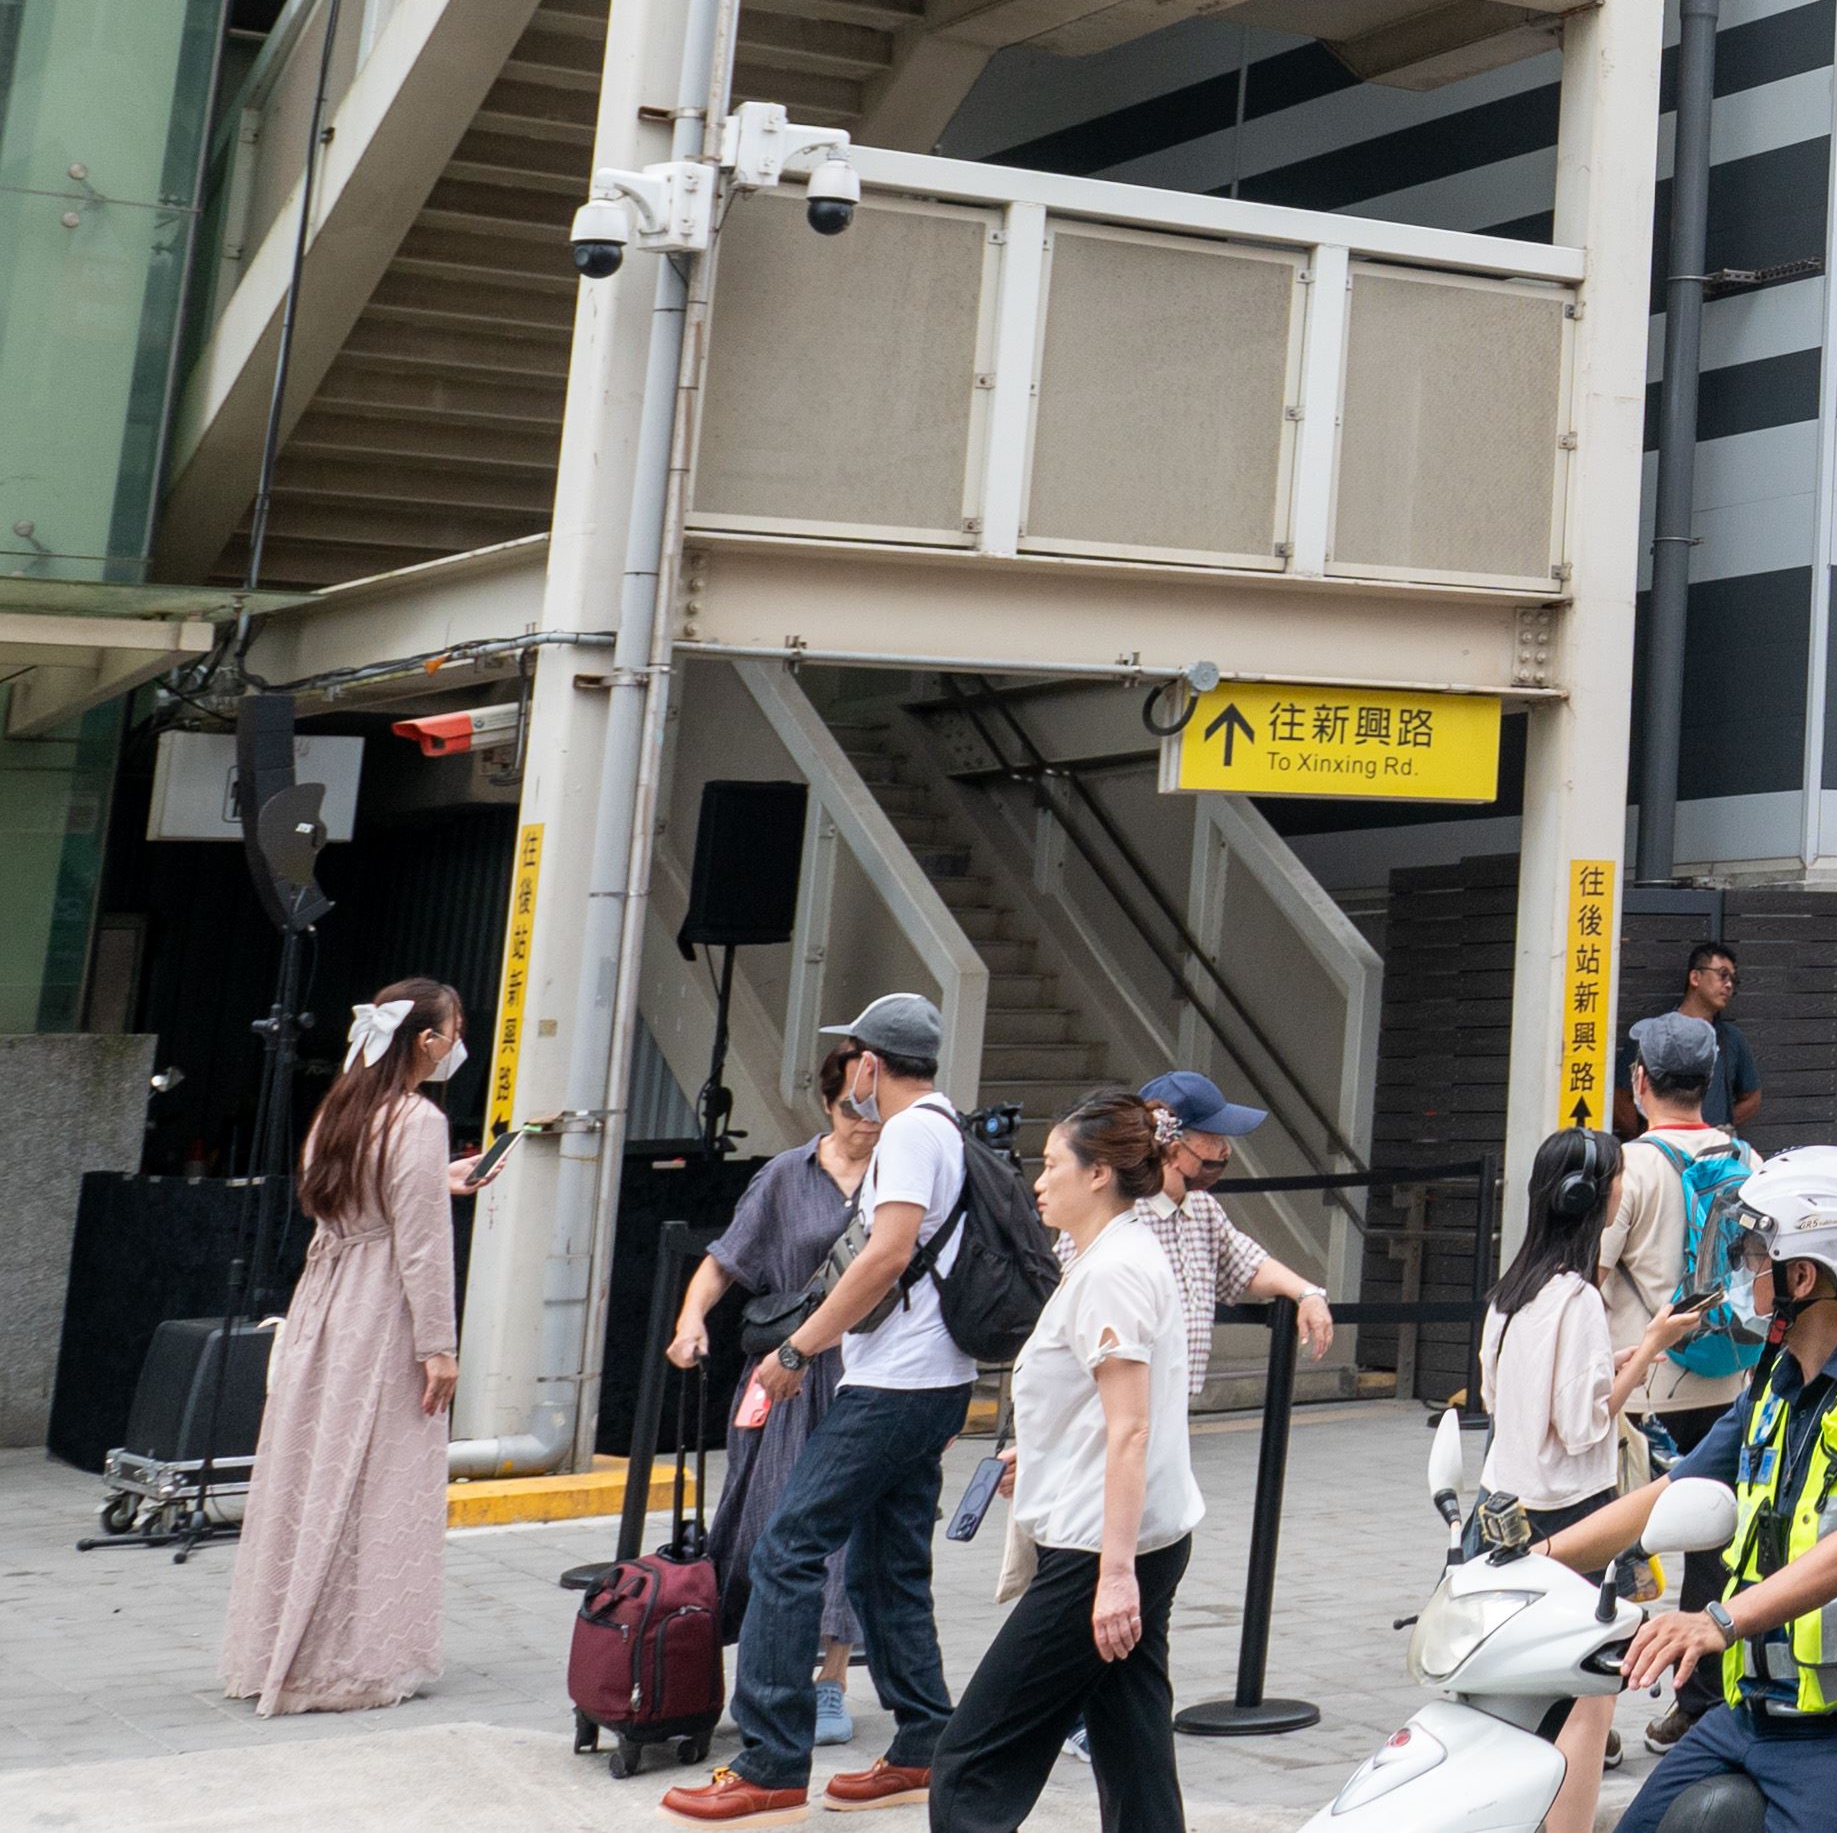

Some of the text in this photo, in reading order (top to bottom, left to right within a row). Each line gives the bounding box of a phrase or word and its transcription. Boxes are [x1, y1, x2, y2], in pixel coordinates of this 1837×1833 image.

[1268, 702, 1433, 749] 往新興路
[1267, 752, 1419, 779] To Xinxing Rd.
[1569, 866, 1605, 1093] 往後站新興路
